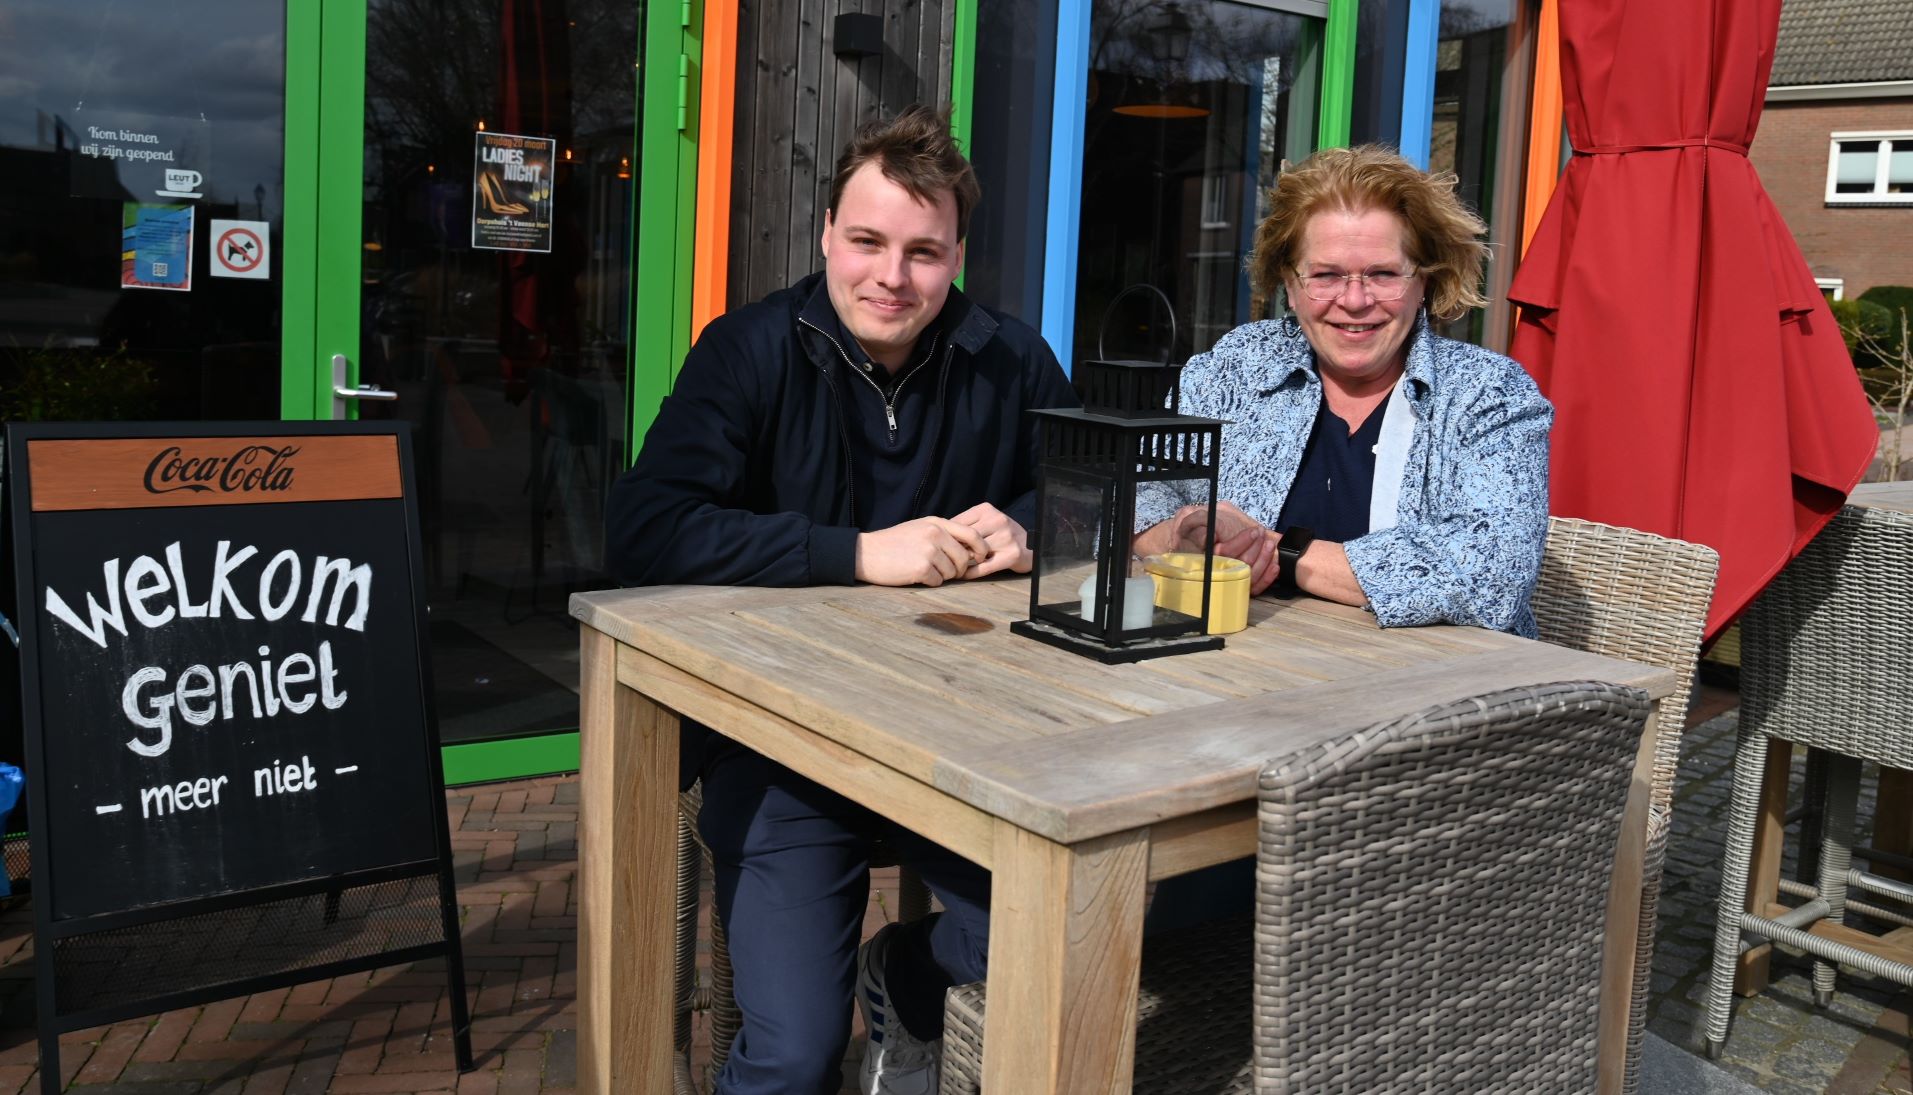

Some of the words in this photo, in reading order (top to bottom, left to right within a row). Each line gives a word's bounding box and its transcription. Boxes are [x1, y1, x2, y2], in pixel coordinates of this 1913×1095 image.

[88, 126, 118, 140] Kom
[119, 129, 159, 144] binnen
[81, 143, 99, 159] wij
[101, 144, 124, 160] zijn
[126, 149, 174, 162] geopend
[482, 147, 524, 165] LADIES
[168, 174, 190, 182] LEUT
[504, 164, 542, 183] NIGHT
[143, 445, 302, 494] Coca-Cola
[141, 776, 228, 818] meer
[254, 756, 317, 796] niet
